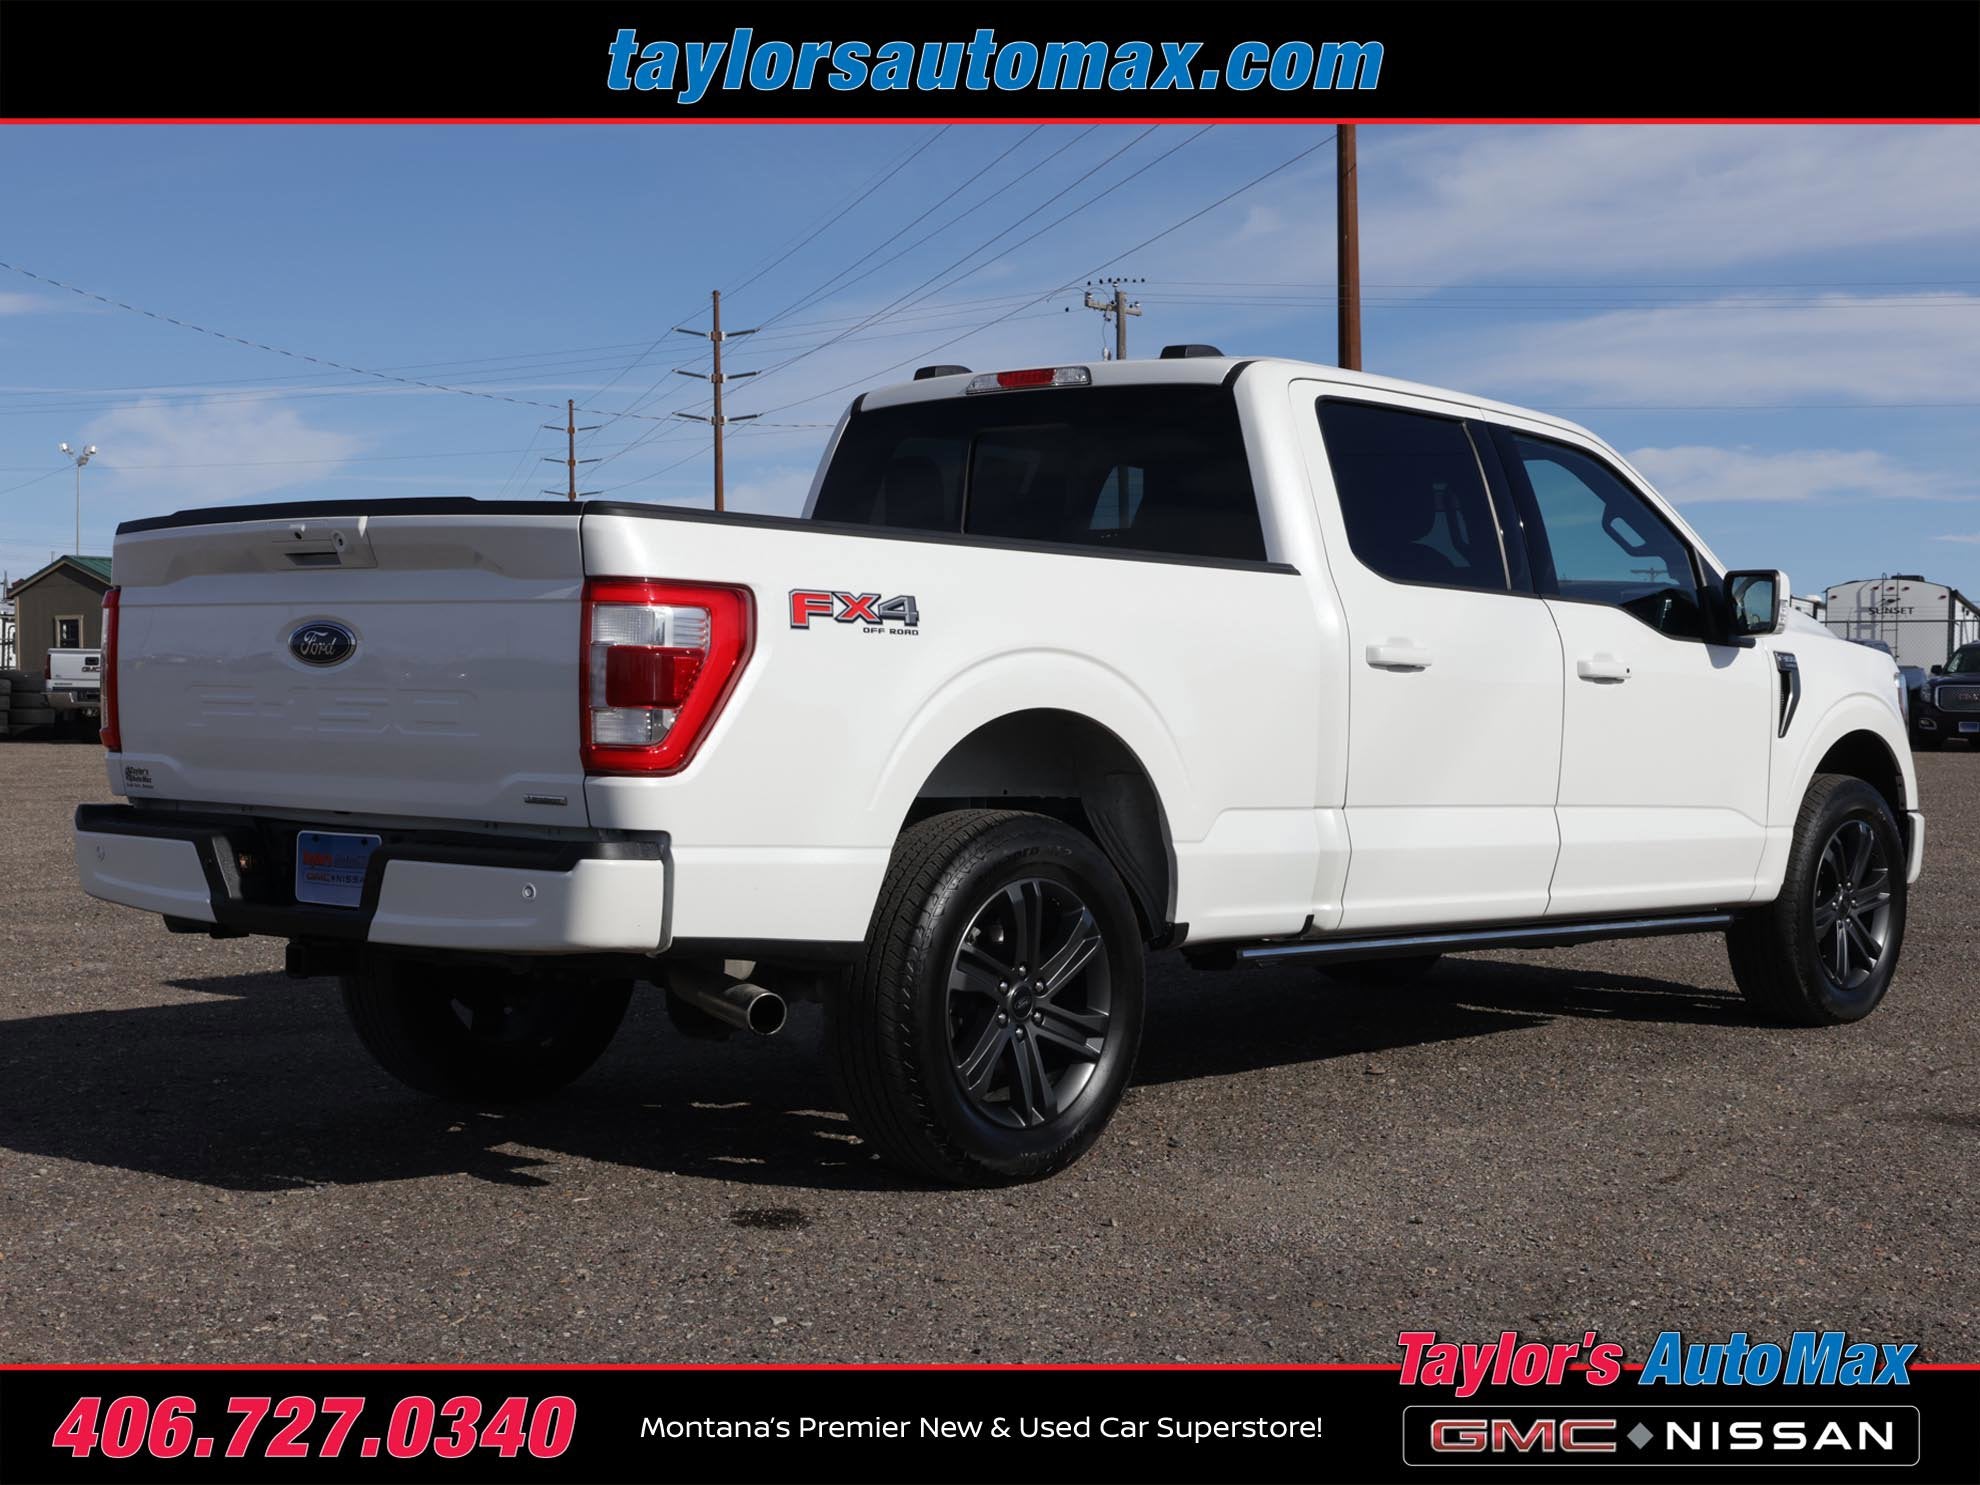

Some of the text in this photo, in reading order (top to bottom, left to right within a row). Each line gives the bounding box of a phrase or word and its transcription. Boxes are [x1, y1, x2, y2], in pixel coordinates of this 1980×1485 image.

[789, 589, 919, 630] FX4
[1868, 607, 1914, 615] SUNSET
[889, 628, 919, 636] ROAD
[300, 630, 337, 656] Ford
